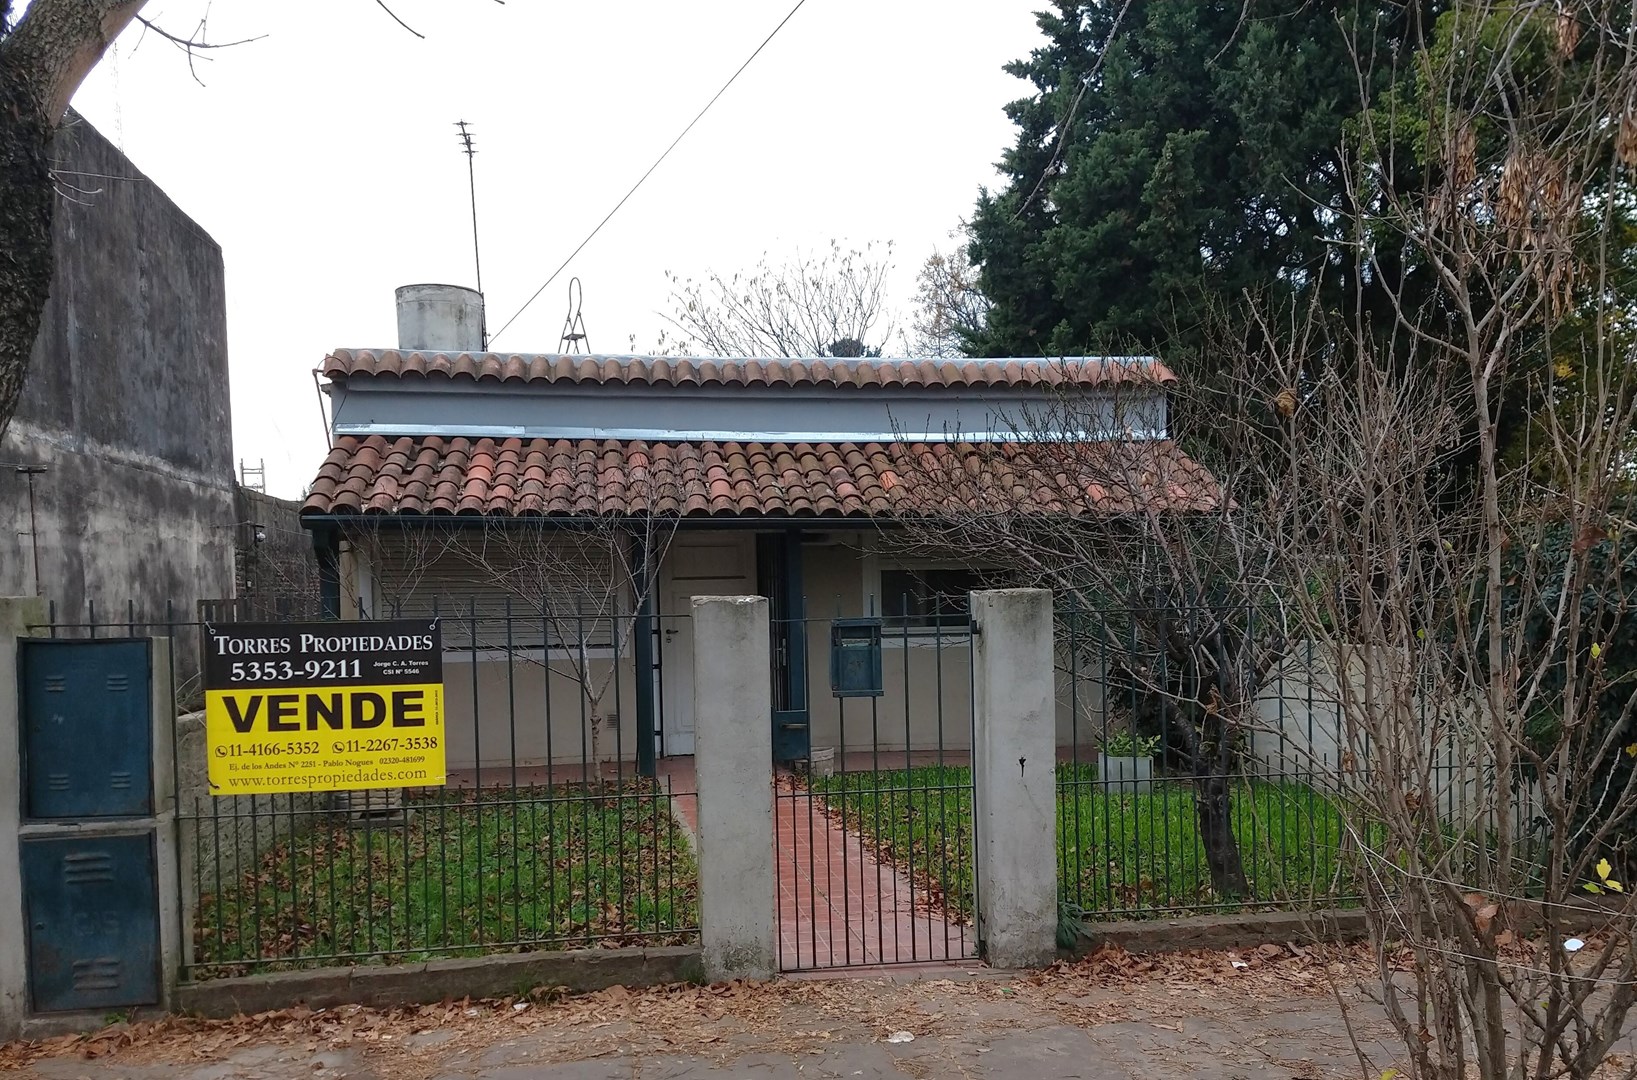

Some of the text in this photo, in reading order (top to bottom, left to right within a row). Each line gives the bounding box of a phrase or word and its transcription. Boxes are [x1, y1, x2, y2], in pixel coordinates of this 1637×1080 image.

[299, 633, 434, 654] PROPIEDADES
[230, 658, 363, 682] 5353-9211
[404, 667, 420, 675] 5546
[221, 690, 426, 733] VENDE
[229, 741, 320, 757] 11-4166-5352
[346, 736, 438, 752] 11-2267-3538
[229, 764, 239, 772] Ej.
[252, 762, 262, 770] los
[264, 762, 287, 770] Andes
[301, 760, 316, 768] 2251
[345, 759, 373, 767] Nogues
[379, 756, 425, 765] 02320-481699
[229, 768, 427, 788] www.torrespropiedades.com
